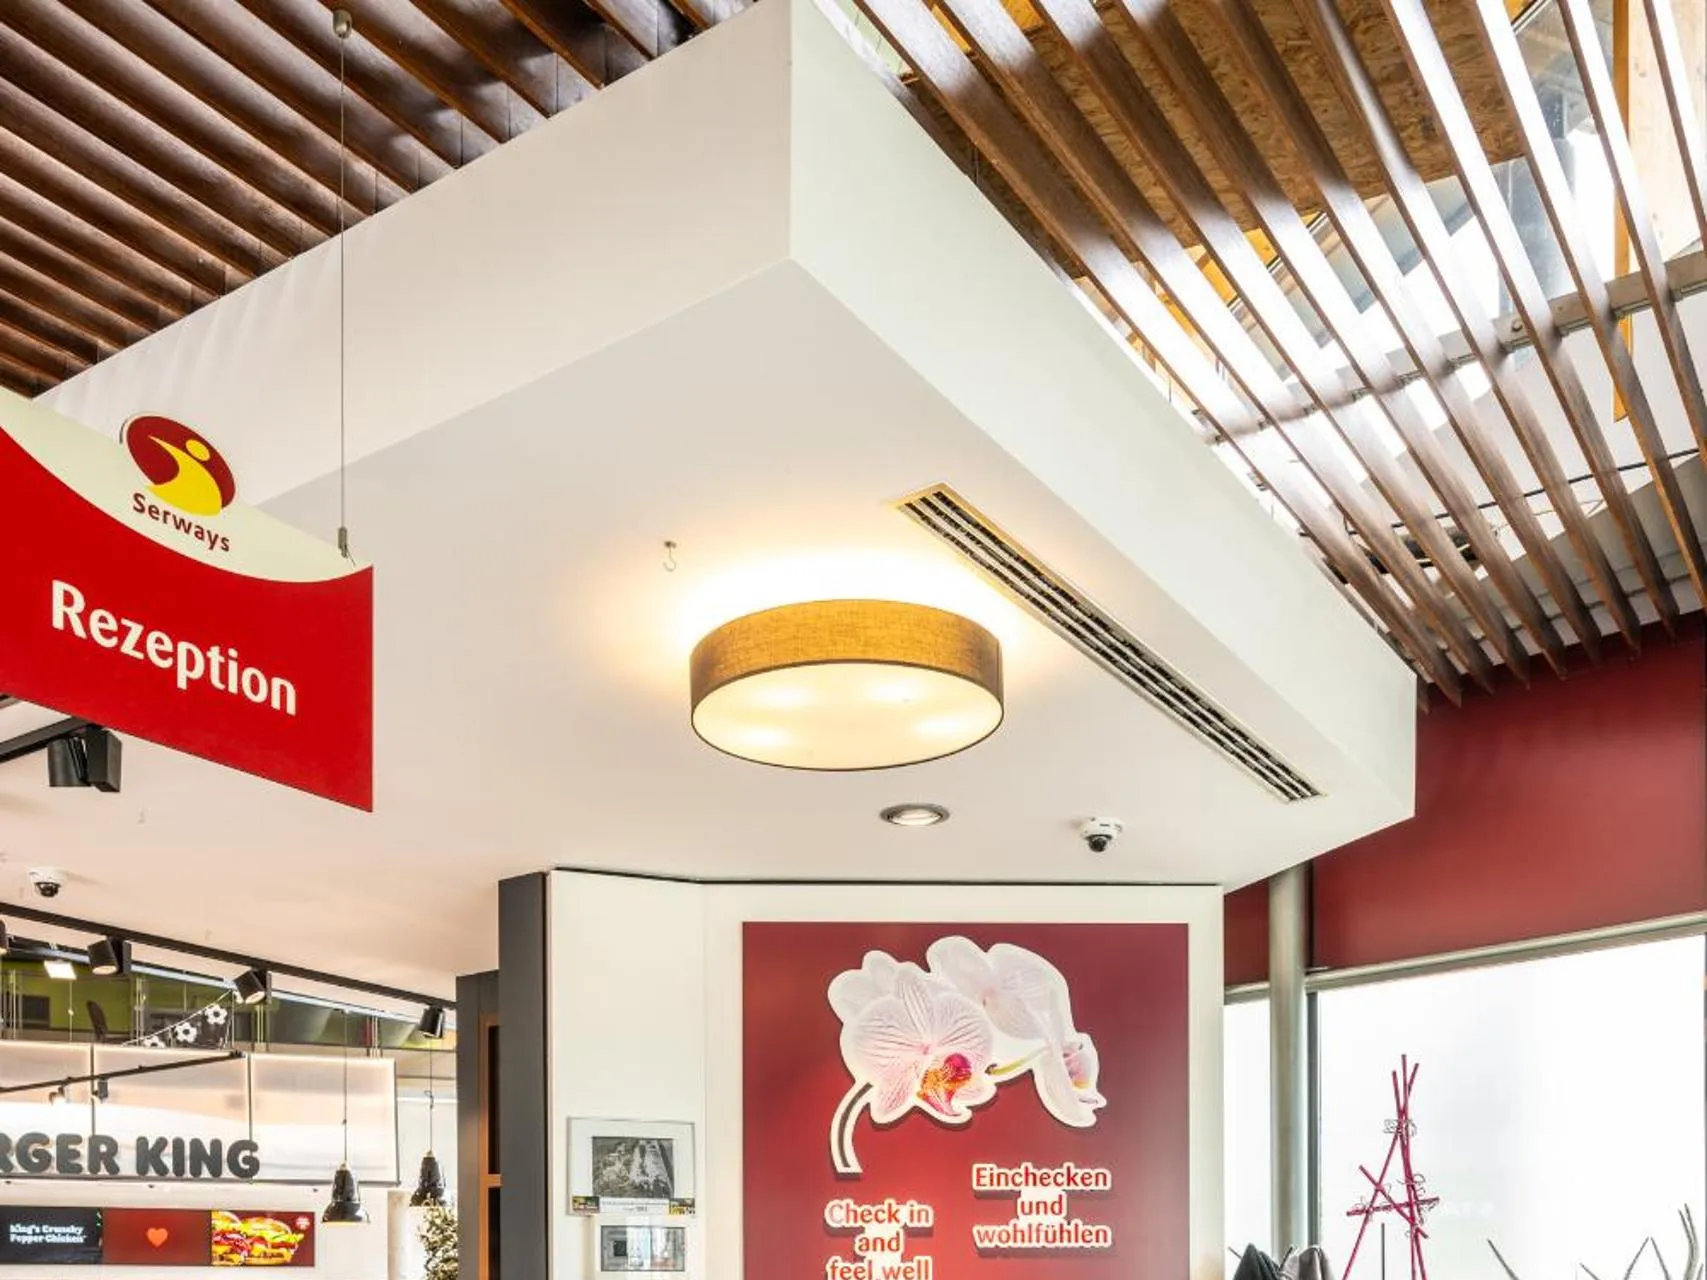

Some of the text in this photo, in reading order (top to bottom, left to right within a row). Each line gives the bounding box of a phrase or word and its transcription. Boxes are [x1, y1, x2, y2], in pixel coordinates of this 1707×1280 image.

[132, 492, 231, 552] Serways
[51, 579, 297, 716] Rezeption
[135, 1136, 261, 1178] KING
[975, 1165, 1108, 1187] Einchecken
[828, 1202, 930, 1225] Check in
[1020, 1193, 1064, 1216] und
[857, 1230, 901, 1253] and
[975, 1222, 1109, 1244] wohlfühlen
[829, 1258, 930, 1280] feel well
